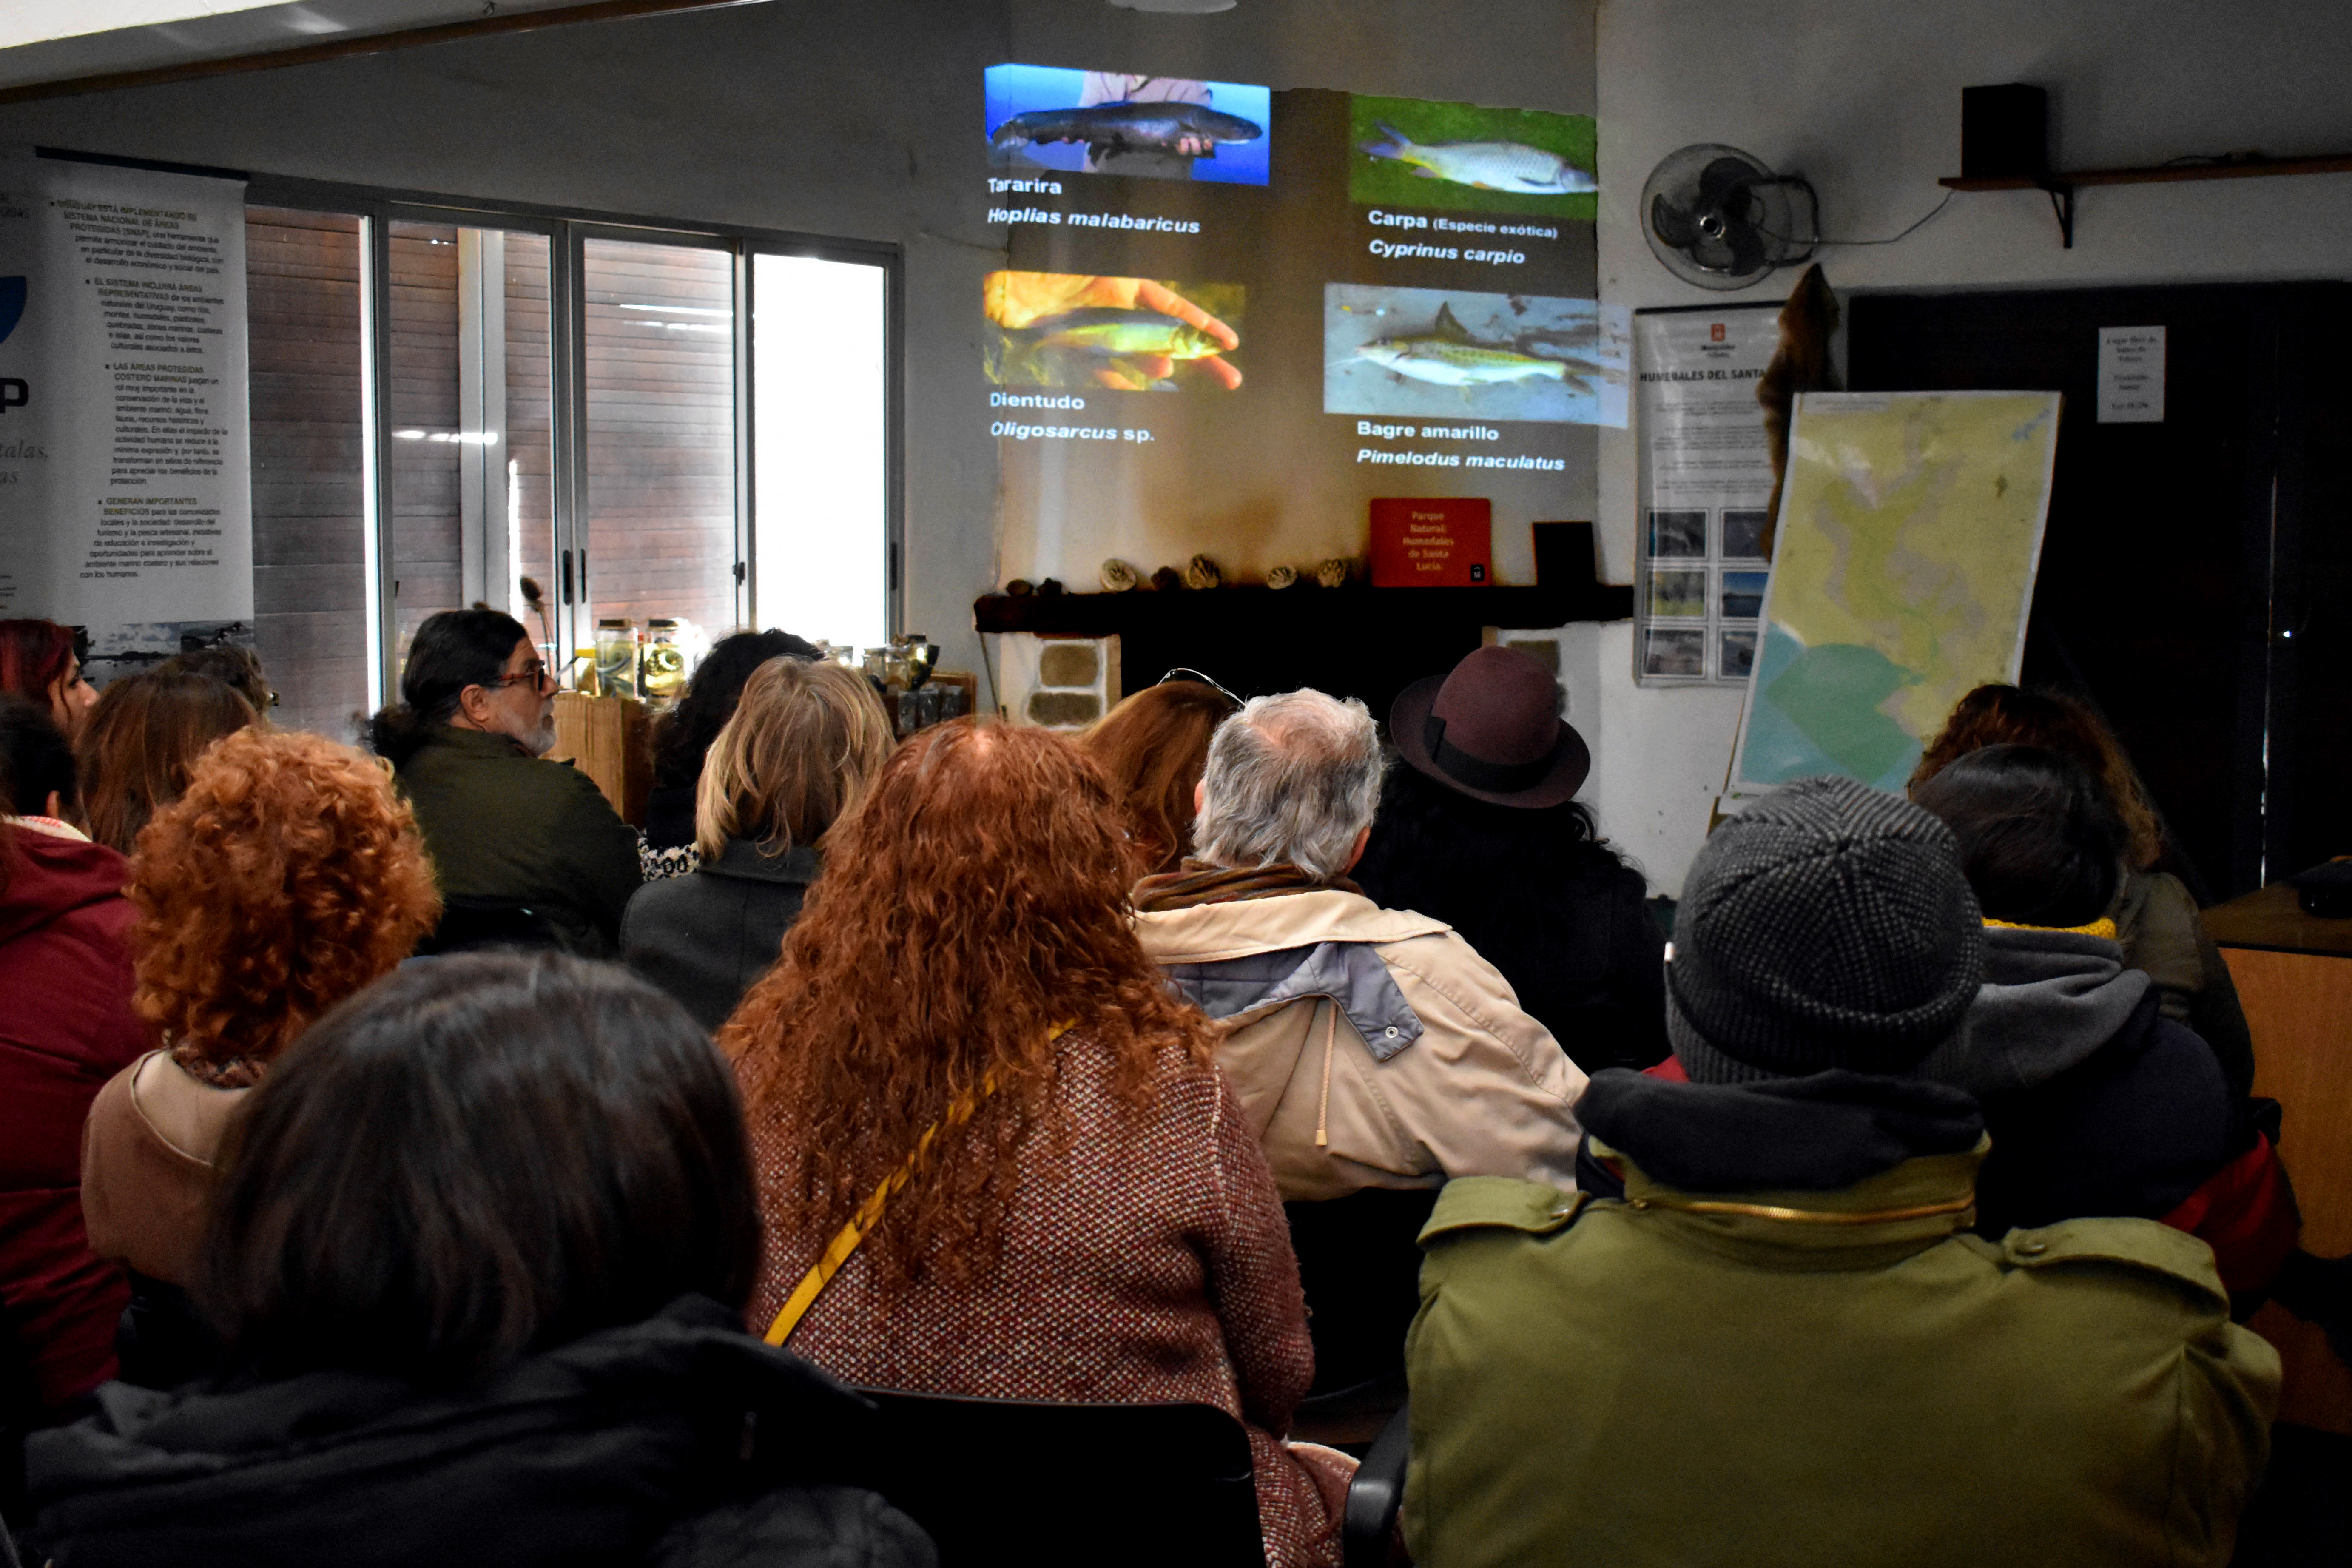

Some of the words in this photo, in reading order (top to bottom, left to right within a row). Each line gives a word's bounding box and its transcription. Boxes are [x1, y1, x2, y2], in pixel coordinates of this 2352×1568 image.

[987, 177, 1062, 194] Tararira
[987, 208, 1061, 225] Hoplias
[1068, 212, 1201, 233] malabaricus
[1368, 210, 1428, 230] Carpa
[1433, 218, 1496, 234] (Especie
[1500, 223, 1558, 239] exótica)
[1369, 240, 1458, 260] Cyprinus
[1464, 248, 1526, 265] carpio
[1707, 370, 1728, 380] DEL
[990, 392, 1085, 410] Dientudo
[991, 421, 1117, 441] Oligosarcus
[1123, 430, 1155, 444] sp.
[1357, 421, 1415, 439] Bagre
[1421, 426, 1500, 440] amarillo
[1357, 449, 1460, 467] Pimelodus
[1465, 455, 1565, 470] maculatus
[1412, 511, 1445, 521] Parque
